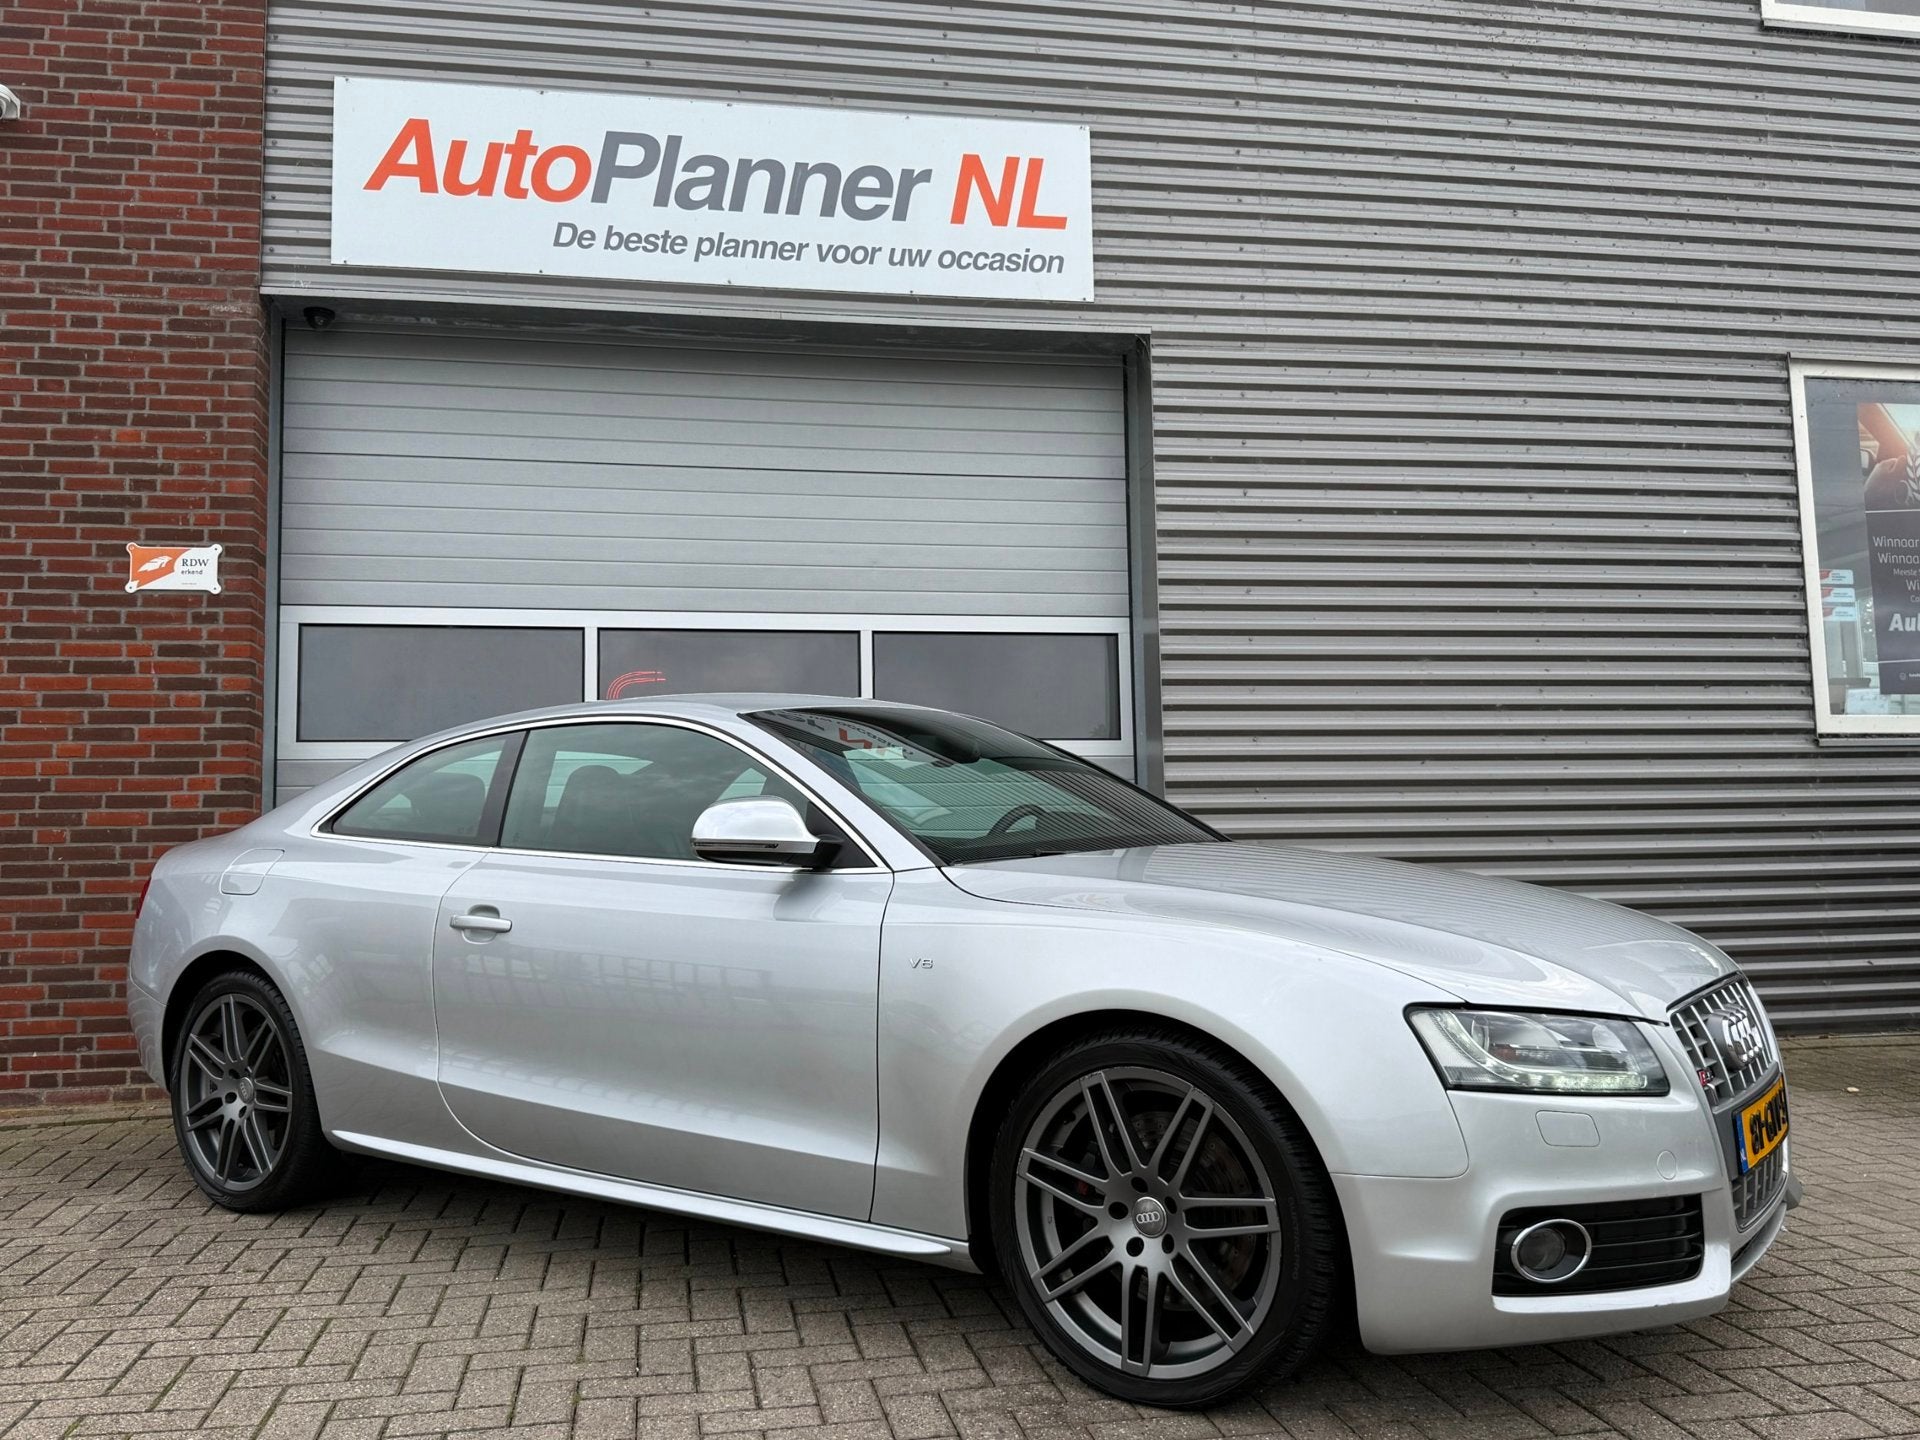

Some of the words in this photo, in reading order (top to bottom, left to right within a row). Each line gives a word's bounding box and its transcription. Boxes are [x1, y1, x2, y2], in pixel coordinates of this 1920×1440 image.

[365, 119, 932, 221] AutoPlanner
[951, 154, 1066, 229] NL
[553, 222, 597, 250] De
[604, 225, 688, 255] beste
[694, 231, 809, 262] planner
[817, 243, 882, 265] voor
[889, 247, 933, 268] uw
[938, 250, 1065, 274] occasion
[181, 558, 209, 567] RDW
